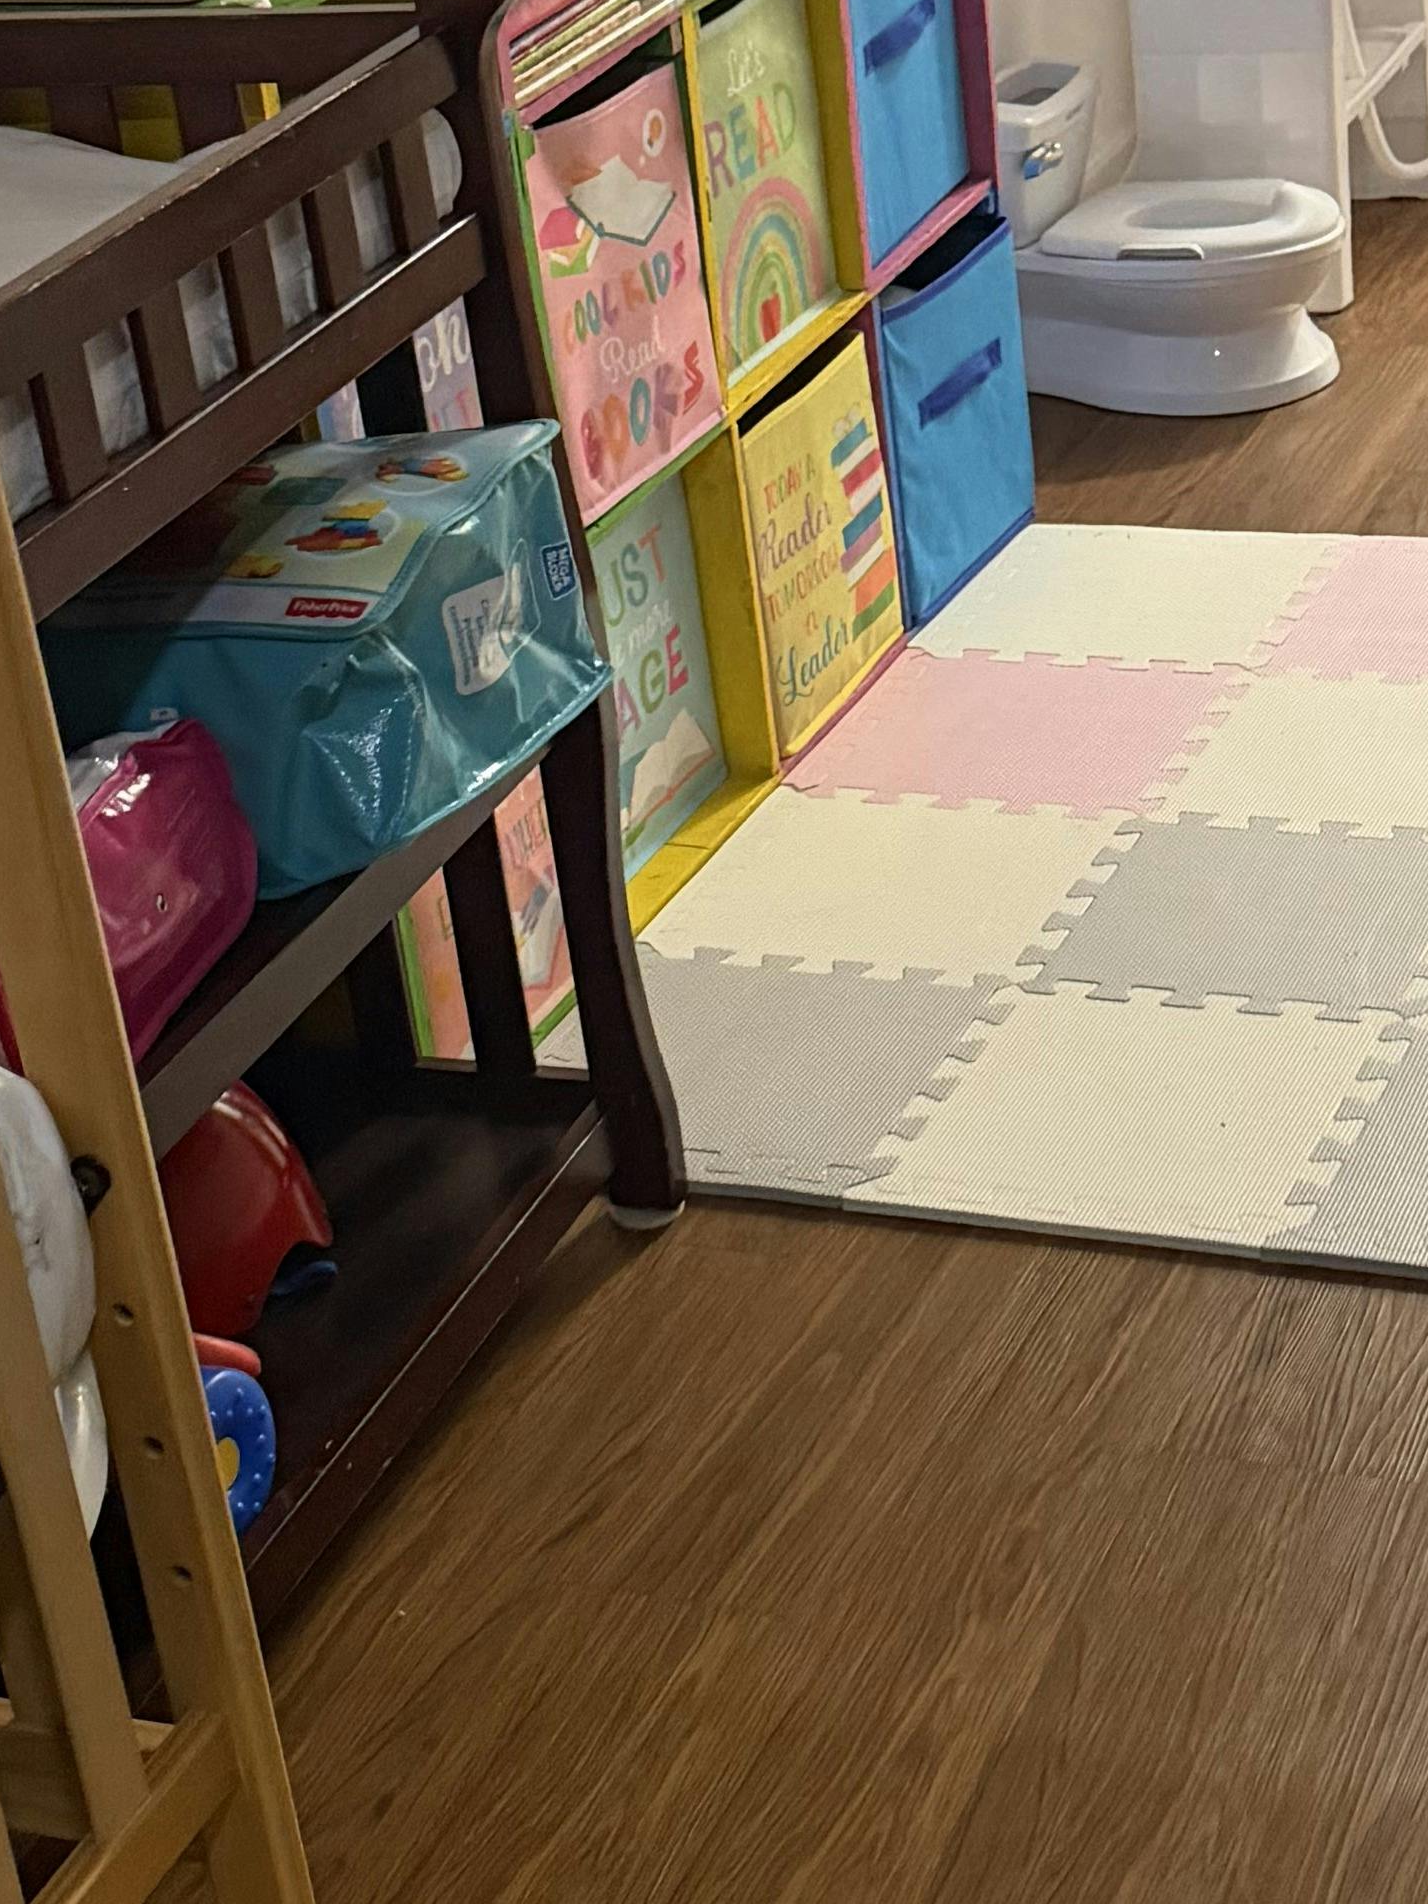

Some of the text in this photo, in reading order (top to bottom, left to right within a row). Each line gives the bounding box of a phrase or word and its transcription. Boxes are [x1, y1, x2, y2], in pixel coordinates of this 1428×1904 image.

[726, 40, 766, 98] Let's
[703, 81, 797, 199] READ
[562, 239, 687, 358] COOL KIDS
[600, 313, 666, 384] Read
[579, 339, 705, 480] BOOKS
[598, 523, 668, 628] UST
[755, 491, 833, 580] Reader
[615, 623, 690, 748] AGE
[776, 613, 850, 708] Leader
